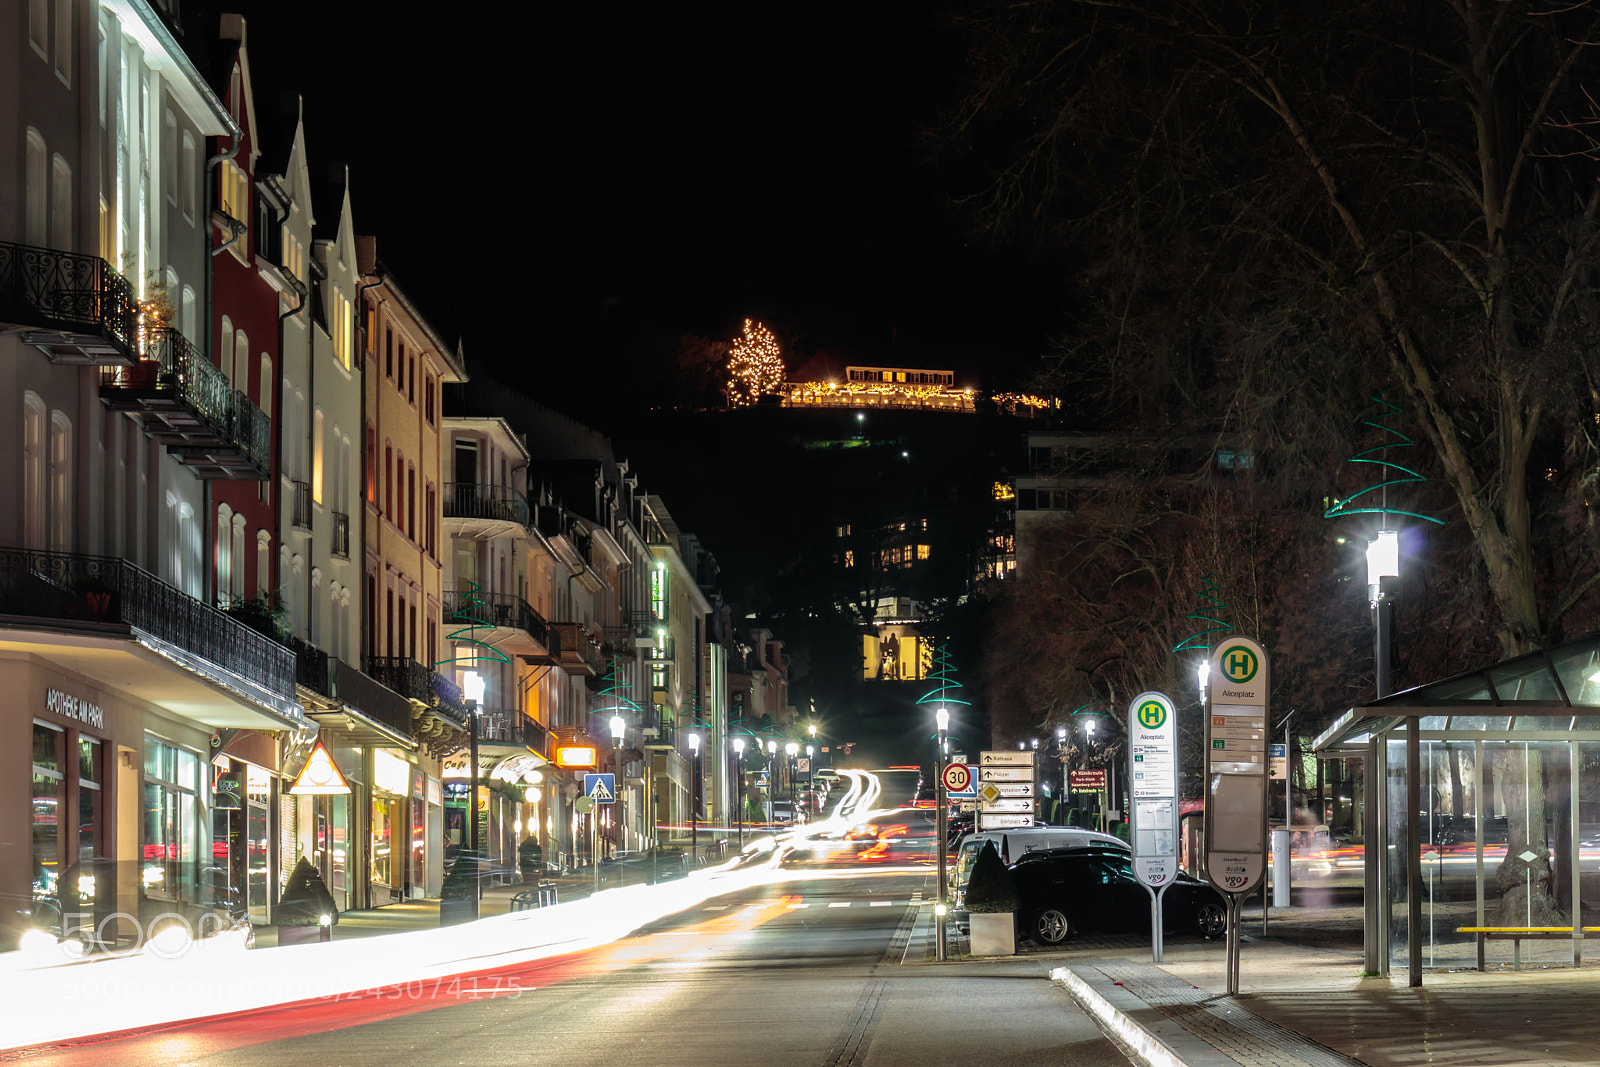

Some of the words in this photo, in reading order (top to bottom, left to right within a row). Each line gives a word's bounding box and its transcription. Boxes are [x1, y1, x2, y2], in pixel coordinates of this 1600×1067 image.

[1222, 689, 1255, 699] Aliceplatz
[46, 687, 79, 720] APOTHEKE
[78, 699, 88, 724] AM
[87, 701, 104, 730] PARK
[949, 771, 965, 784] 30
[1148, 874, 1162, 883] vgo
[1225, 876, 1242, 887] vgo
